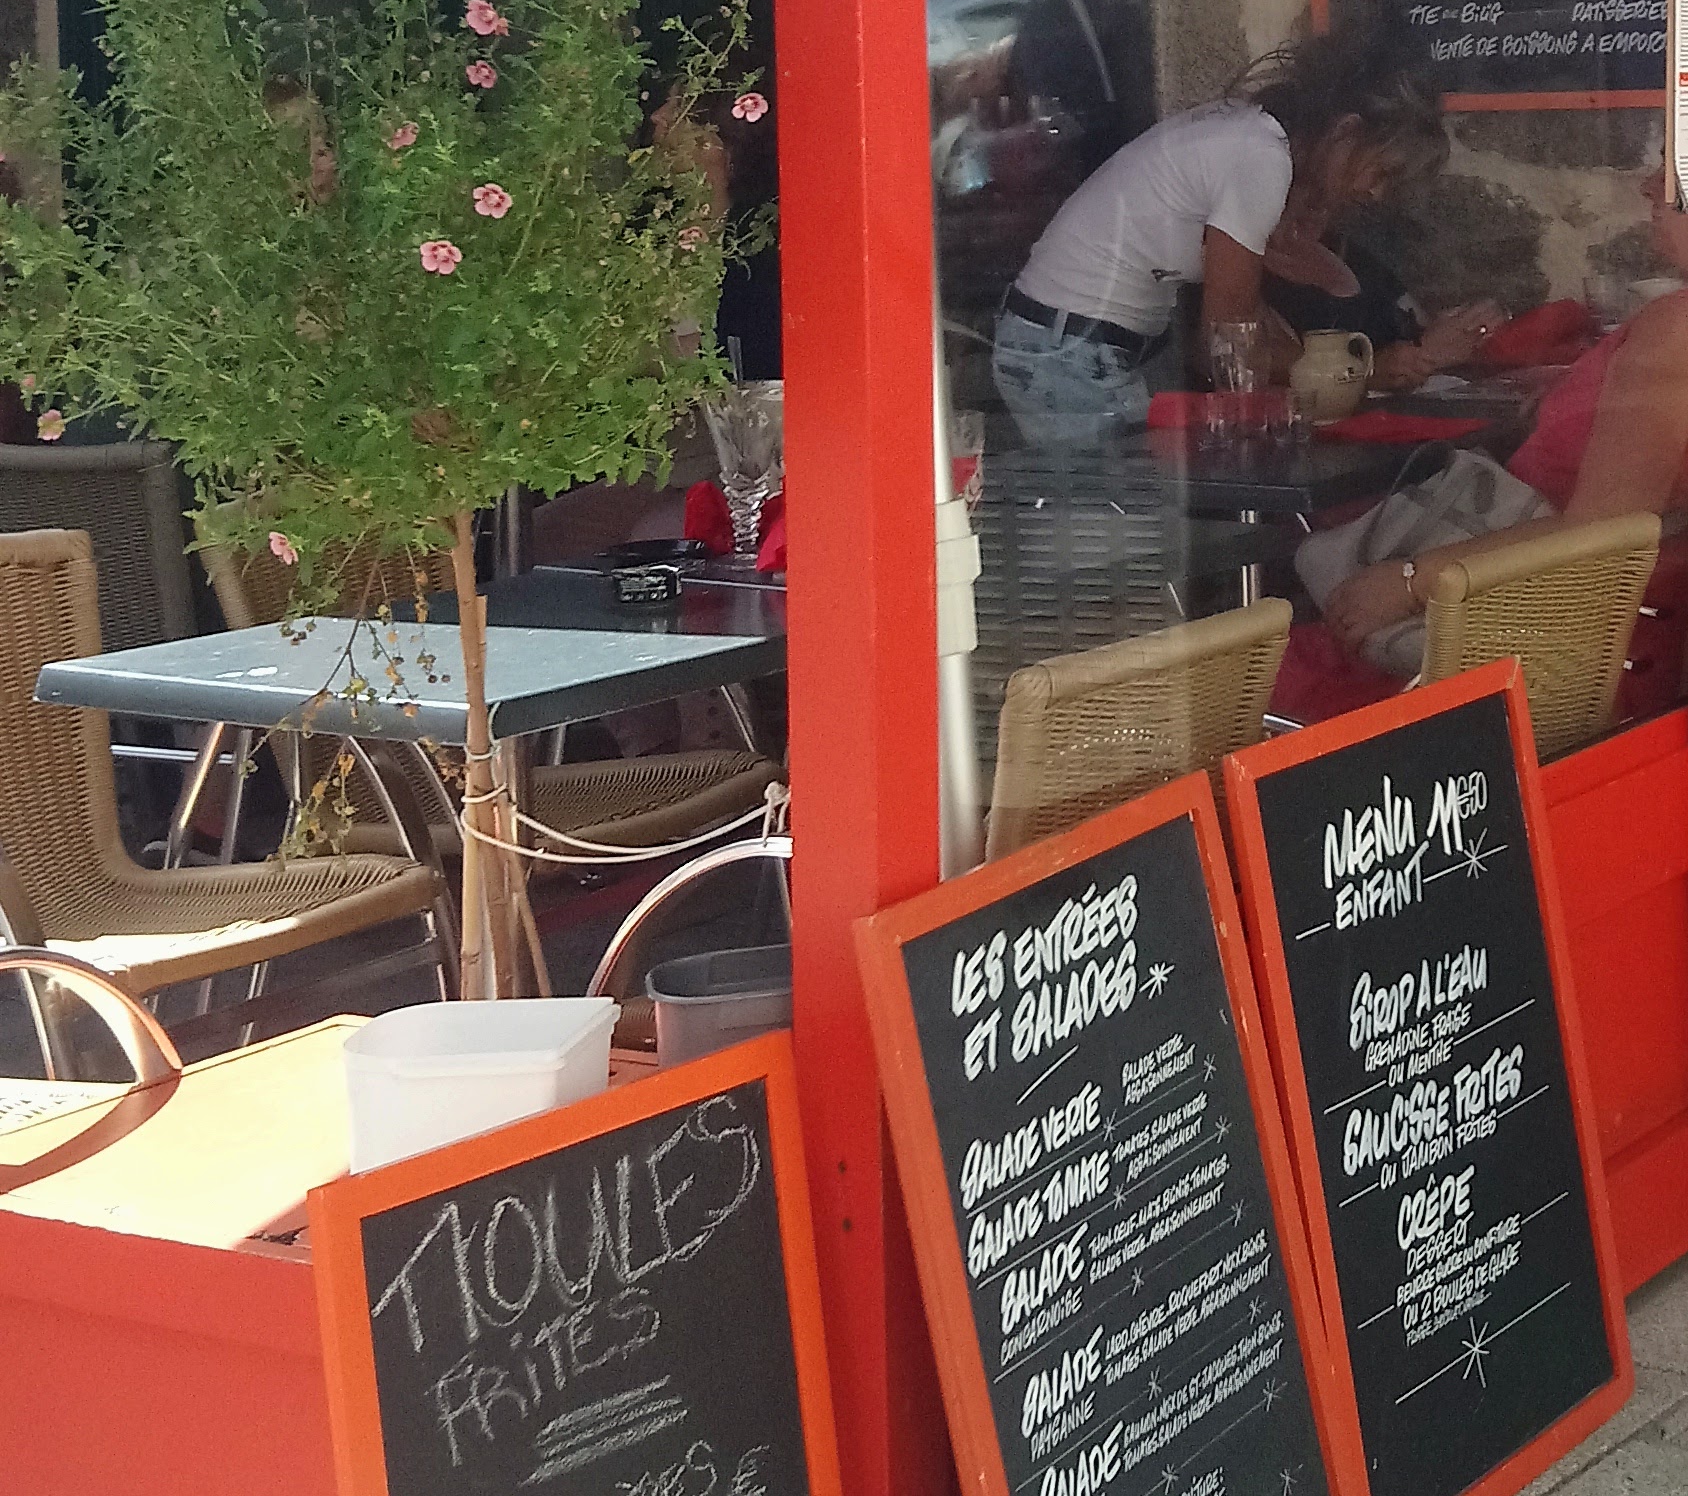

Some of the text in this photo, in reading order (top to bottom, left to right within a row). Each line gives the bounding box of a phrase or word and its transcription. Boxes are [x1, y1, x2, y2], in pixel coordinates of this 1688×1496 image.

[1430, 33, 1475, 61] VENTE
[1476, 35, 1499, 57] DE
[1502, 30, 1578, 57] BOISSONS
[1323, 774, 1416, 889] MENU
[1335, 840, 1430, 931] ENFANT
[951, 874, 1138, 1018] LES ENTRÉES
[963, 939, 1137, 1082] ET SALADES
[1349, 971, 1416, 1052] SIROP
[1433, 943, 1488, 1006] L'EAU
[1431, 1001, 1473, 1040] FRAISE
[1122, 1033, 1184, 1088] SALADE VERTE
[1388, 1036, 1455, 1088] OU MENTHE
[960, 1081, 1102, 1210] SALADE VERTE
[1182, 1090, 1208, 1124] VERTE
[1343, 1043, 1524, 1177] SAUCISSE FRITES
[1380, 1107, 1497, 1191] OU JAMBON FRITES
[370, 1094, 762, 1354] MOULES
[967, 1149, 1111, 1279] SALADE TOMATE
[1397, 1164, 1476, 1251] CRÊPE
[1406, 1210, 1475, 1276] DESSERT
[1001, 1221, 1089, 1336] SALADE
[1089, 1248, 1122, 1285] SALADE
[1396, 1266, 1437, 1308] BEURRE
[1403, 1302, 1419, 1331] OU
[1421, 1291, 1432, 1321] 2
[1432, 1266, 1475, 1310] BOULES
[1474, 1262, 1489, 1290] DE
[1488, 1240, 1523, 1283] GLACE
[423, 1285, 662, 1467] FRITES
[1021, 1324, 1103, 1439] SALADE
[1141, 1323, 1174, 1363] SALADE
[1029, 1391, 1096, 1464] PAYSANNE
[1177, 1384, 1189, 1410] DE
